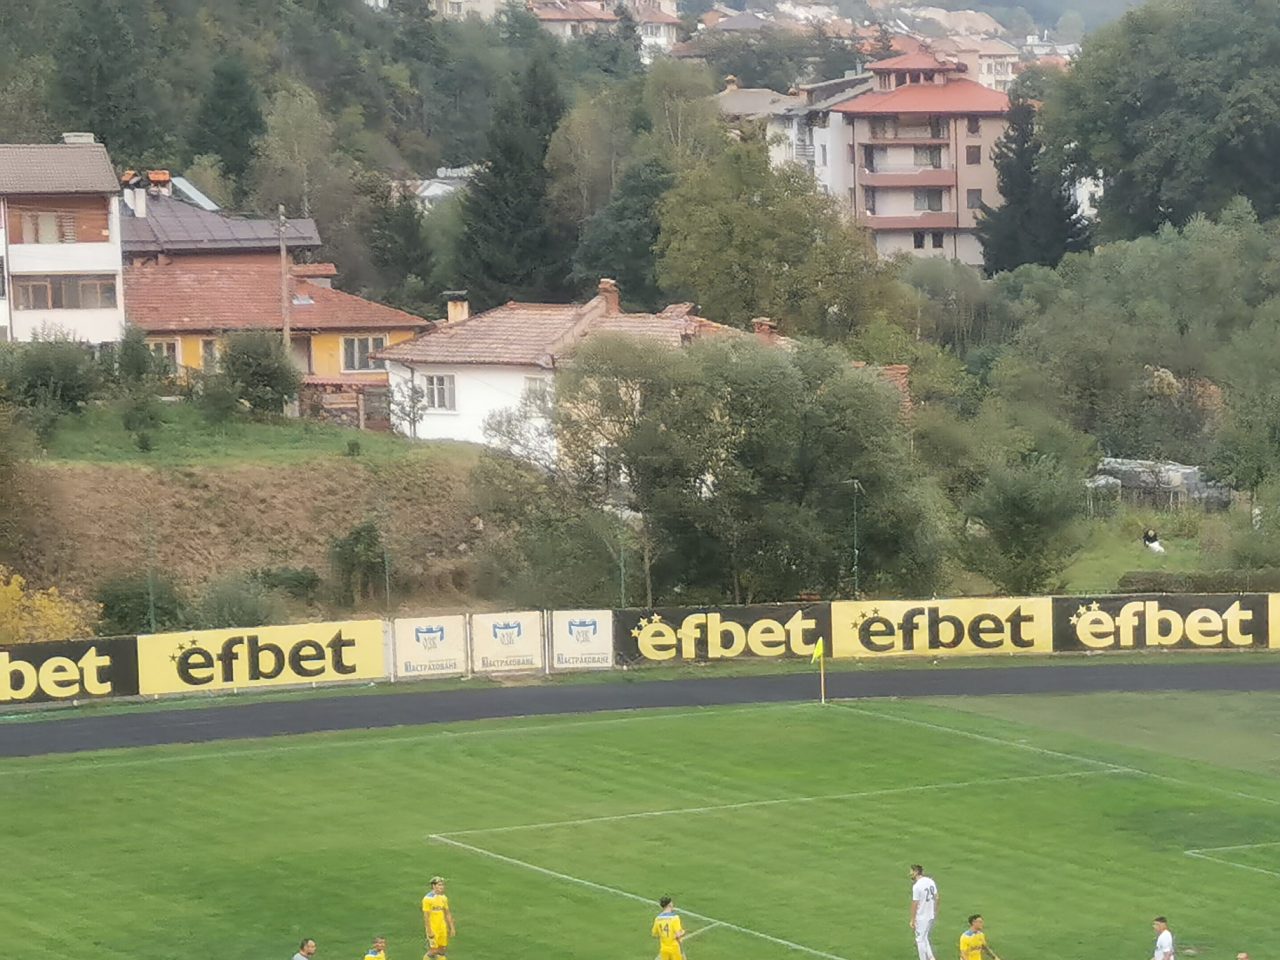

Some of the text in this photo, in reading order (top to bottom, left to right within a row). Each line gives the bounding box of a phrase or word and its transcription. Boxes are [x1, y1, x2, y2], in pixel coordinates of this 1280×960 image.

[637, 610, 817, 661] efbet
[857, 605, 1035, 652] efbet
[1075, 600, 1254, 648] efbet
[176, 629, 357, 687] efbet
